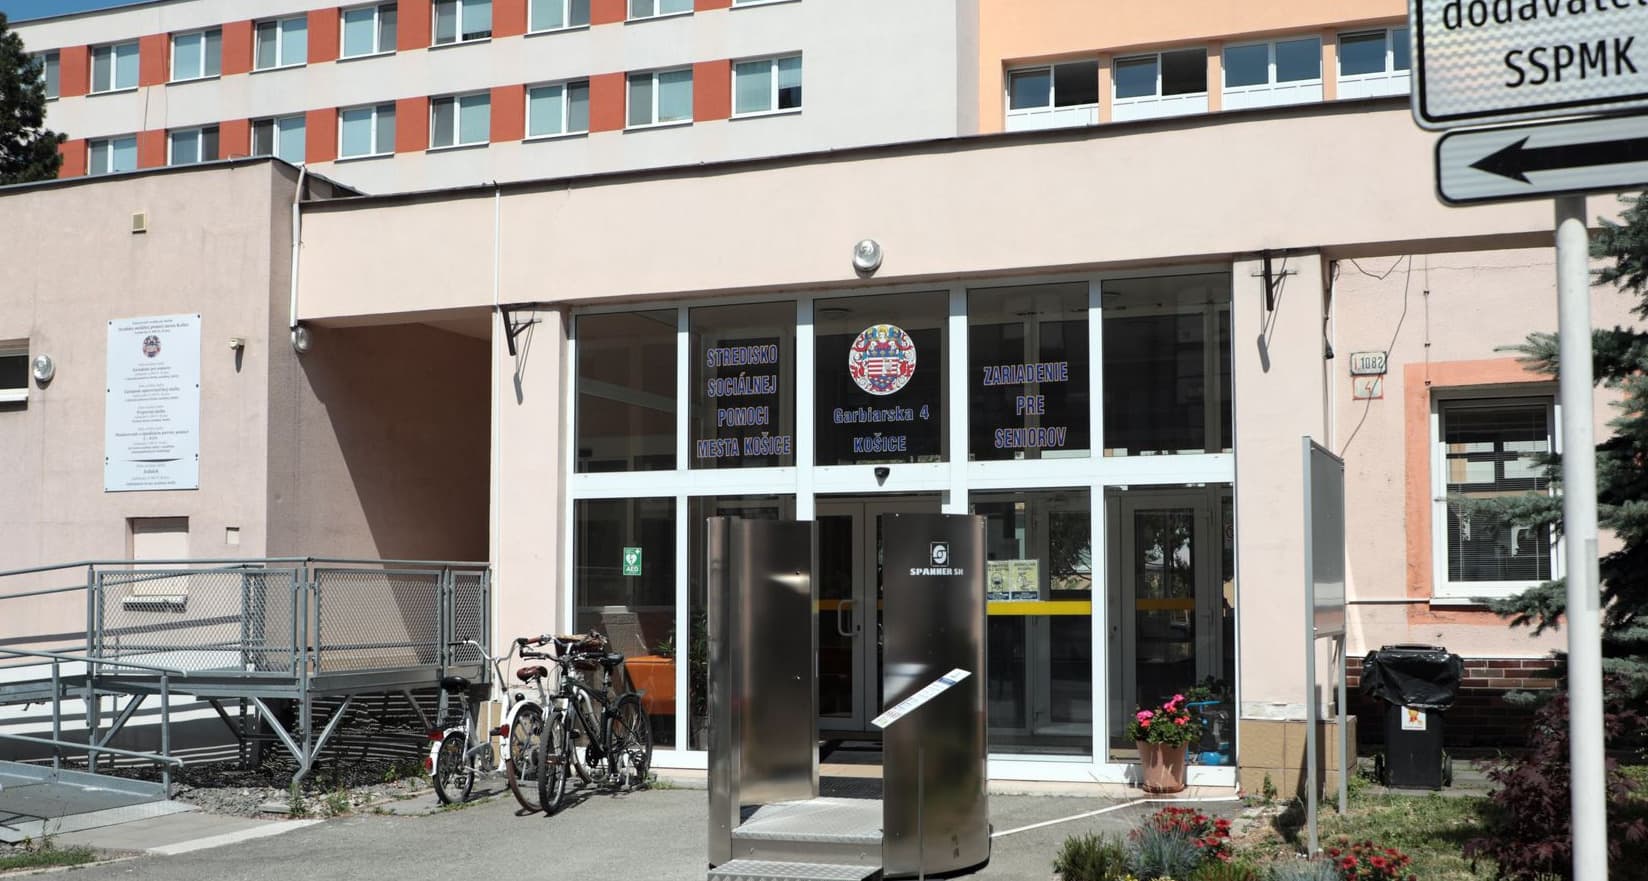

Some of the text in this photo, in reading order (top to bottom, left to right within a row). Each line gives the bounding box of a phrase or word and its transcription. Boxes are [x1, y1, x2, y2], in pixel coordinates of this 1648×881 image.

[1504, 36, 1638, 88] SSPMK
[707, 344, 778, 368] STREDISKO
[1360, 356, 1384, 369] 1082
[708, 371, 777, 397] SOCIÁLNEJ
[983, 361, 1069, 386] ZARIADENIE
[833, 404, 930, 424] Garbiarska 4
[1016, 395, 1045, 415] PRE
[718, 406, 769, 427] POMOCI
[697, 431, 791, 458] MESTA KOŠICE
[853, 432, 907, 453] KOŠICE
[994, 427, 1067, 448] SENIOROV
[909, 567, 952, 576] SPANNER
